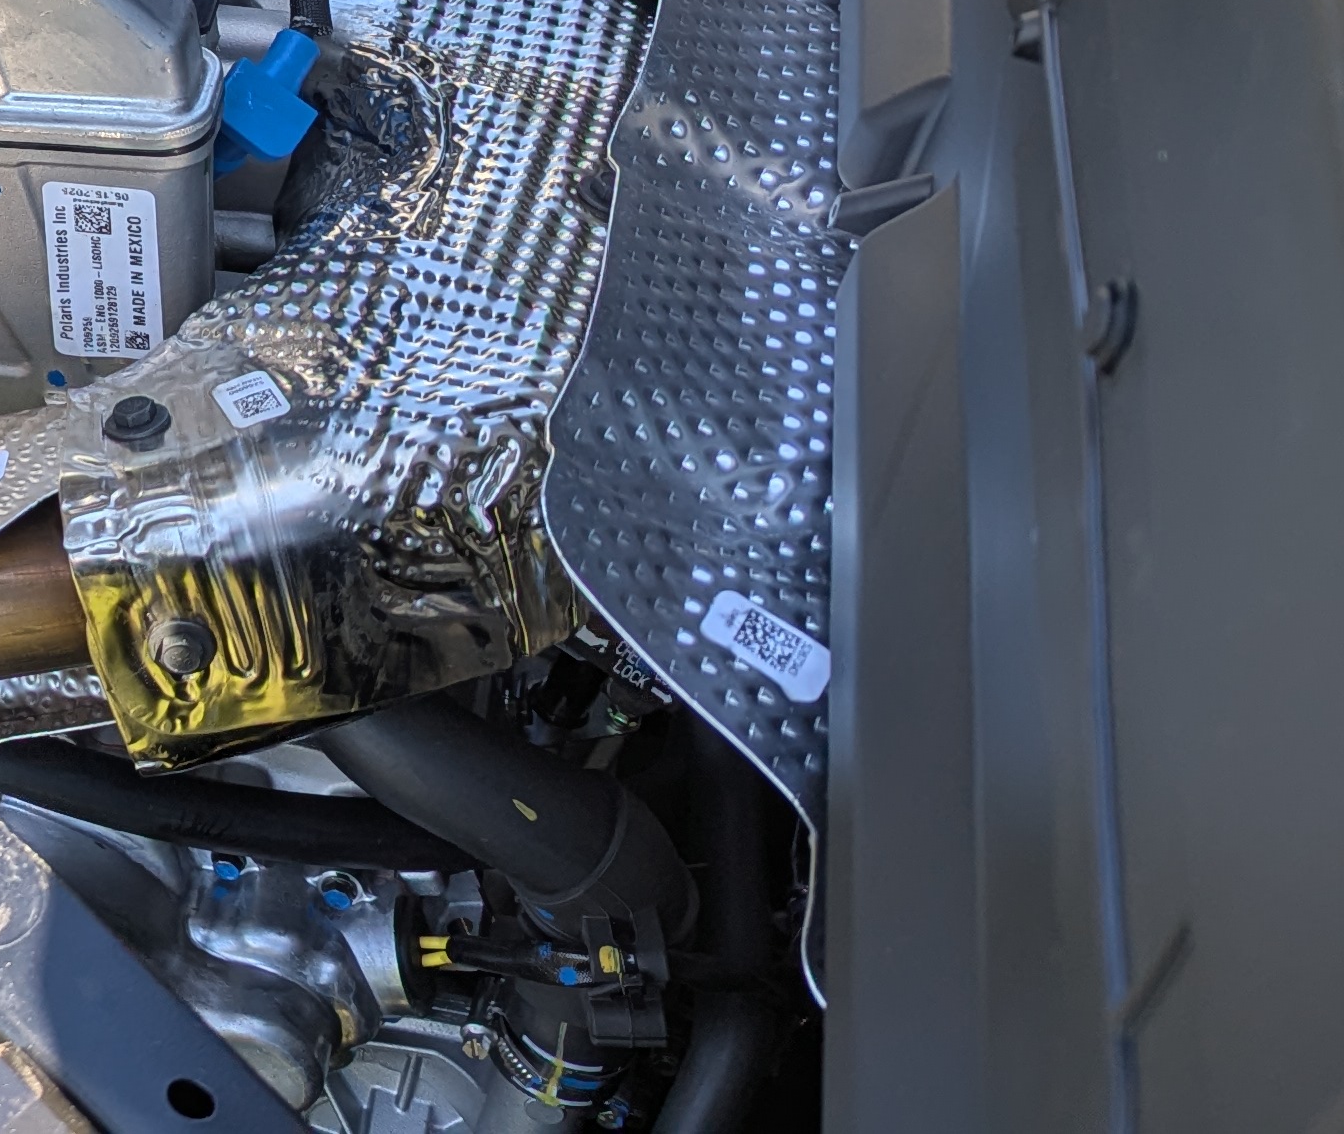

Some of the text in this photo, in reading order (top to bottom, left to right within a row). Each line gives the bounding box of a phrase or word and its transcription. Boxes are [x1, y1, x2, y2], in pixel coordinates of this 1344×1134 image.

[52, 205, 74, 341] Polaris Industries Inc
[126, 216, 146, 327] MADE IN MEXICO
[83, 316, 93, 353] 1209259
[612, 658, 651, 690] LOCK
